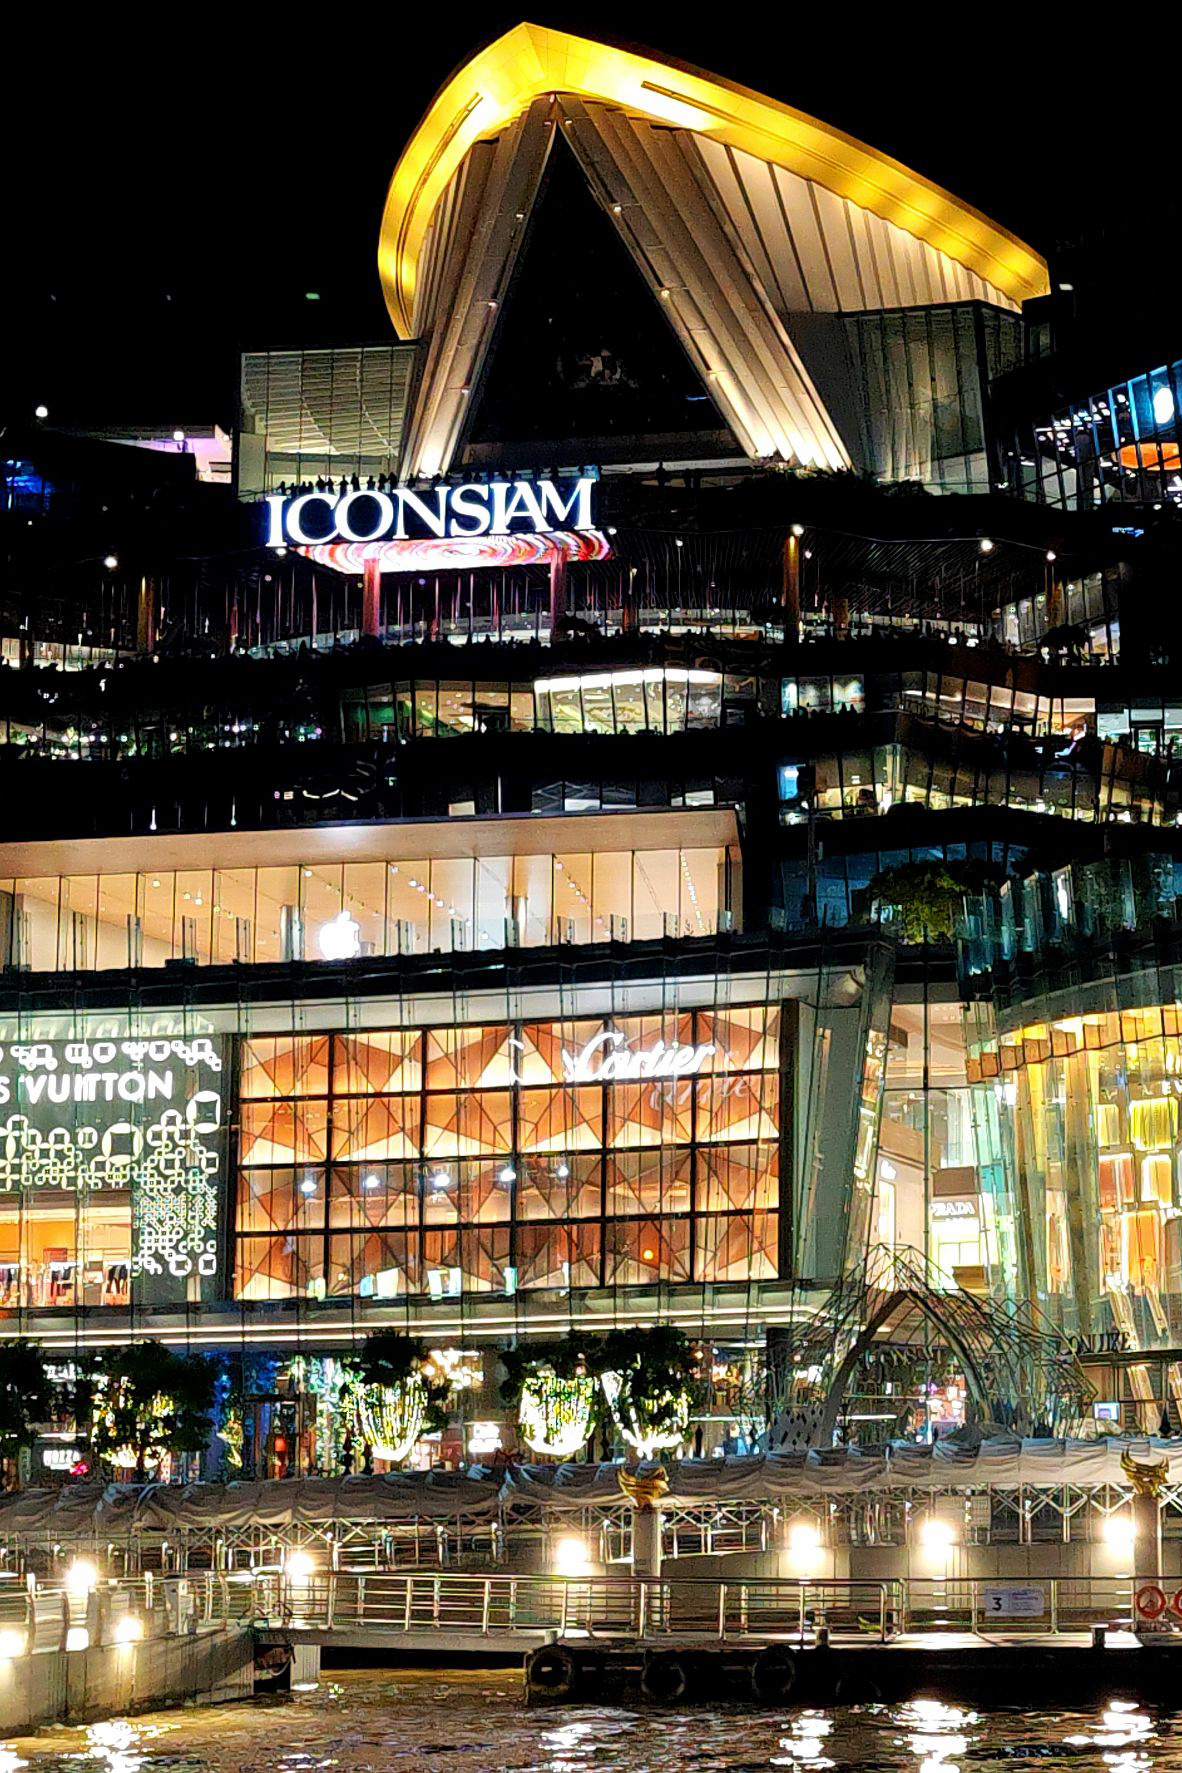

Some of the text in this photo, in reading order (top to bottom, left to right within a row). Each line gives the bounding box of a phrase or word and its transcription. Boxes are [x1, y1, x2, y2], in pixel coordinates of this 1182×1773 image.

[265, 478, 597, 548] ICONSIAM
[562, 1031, 716, 1083] Cartier
[24, 1070, 174, 1104] VUITTON
[991, 1596, 1003, 1612] 3
